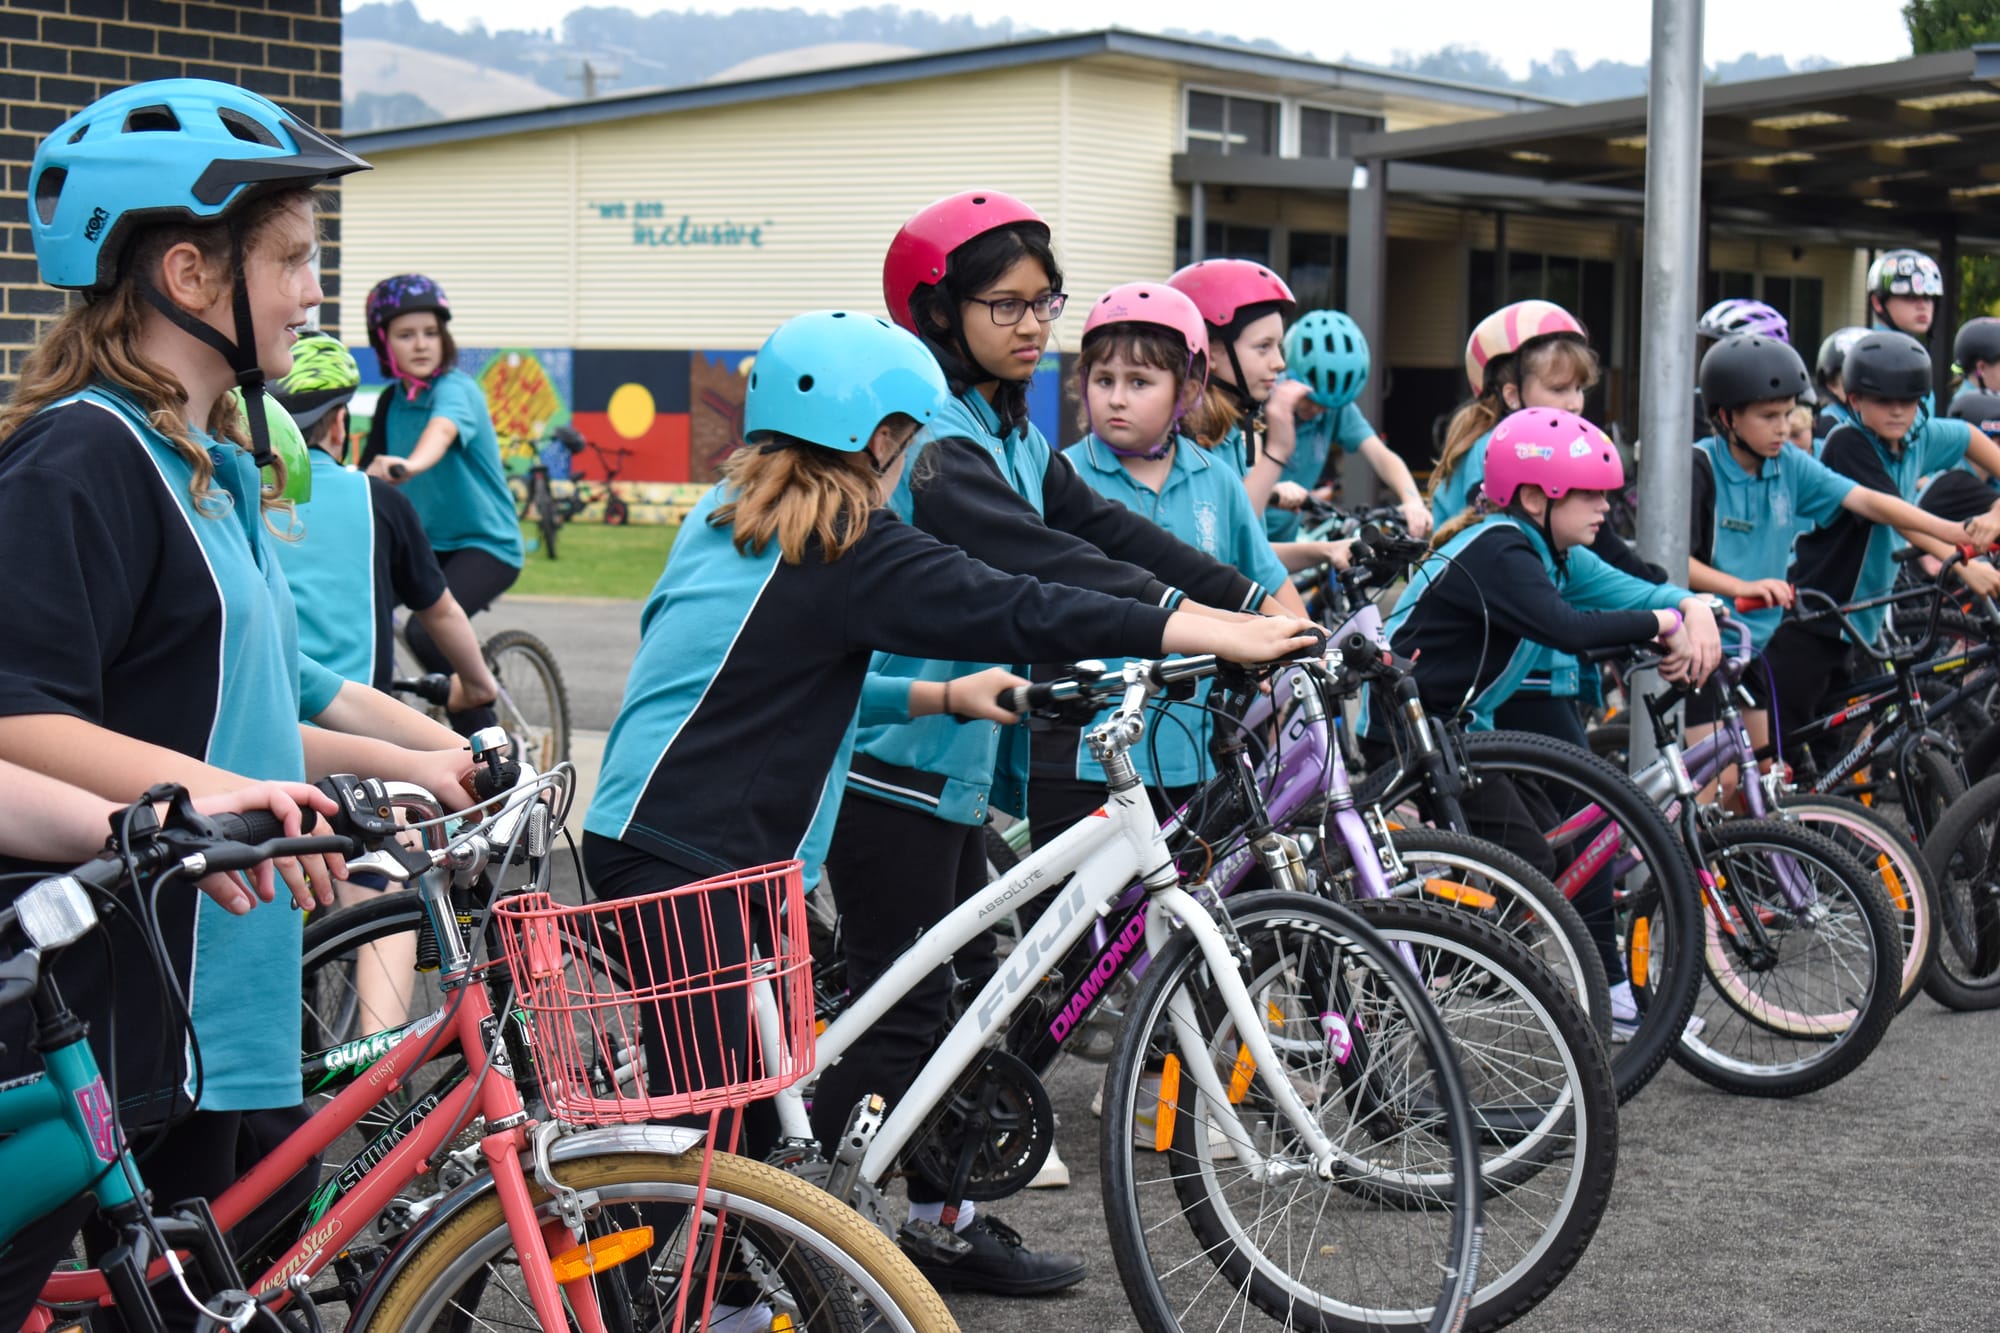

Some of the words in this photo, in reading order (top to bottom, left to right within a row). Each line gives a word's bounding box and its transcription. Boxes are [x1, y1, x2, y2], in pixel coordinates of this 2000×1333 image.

[84, 206, 107, 241] KOR
[977, 868, 1045, 919] ABSOLUTE
[977, 884, 1087, 1033] FUJI
[325, 1030, 403, 1071] QUAKE
[368, 1061, 395, 1087] wisp
[301, 1217, 336, 1260] Star
